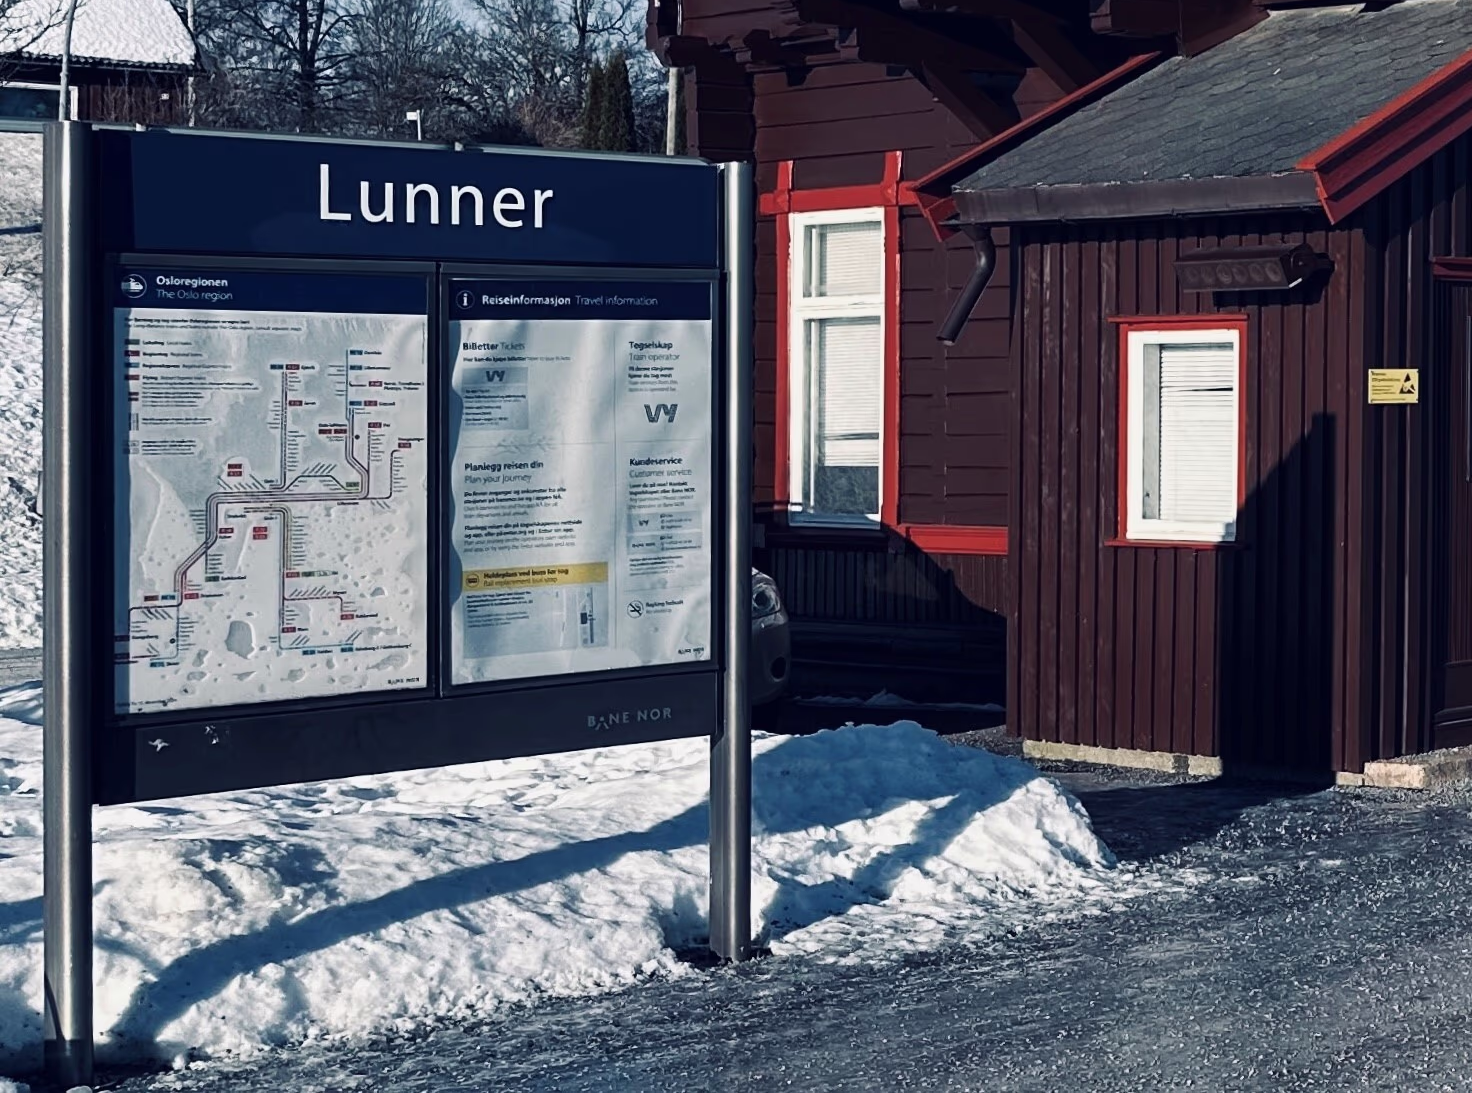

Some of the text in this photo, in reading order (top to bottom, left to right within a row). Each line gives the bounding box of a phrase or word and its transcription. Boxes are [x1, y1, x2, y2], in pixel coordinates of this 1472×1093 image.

[320, 163, 554, 229] Lunner
[156, 275, 229, 289] Osloregionen
[156, 289, 233, 303] The Oslo region
[482, 294, 659, 308] Reiseinformasjon Travel information
[587, 707, 672, 731] BANE NOR
